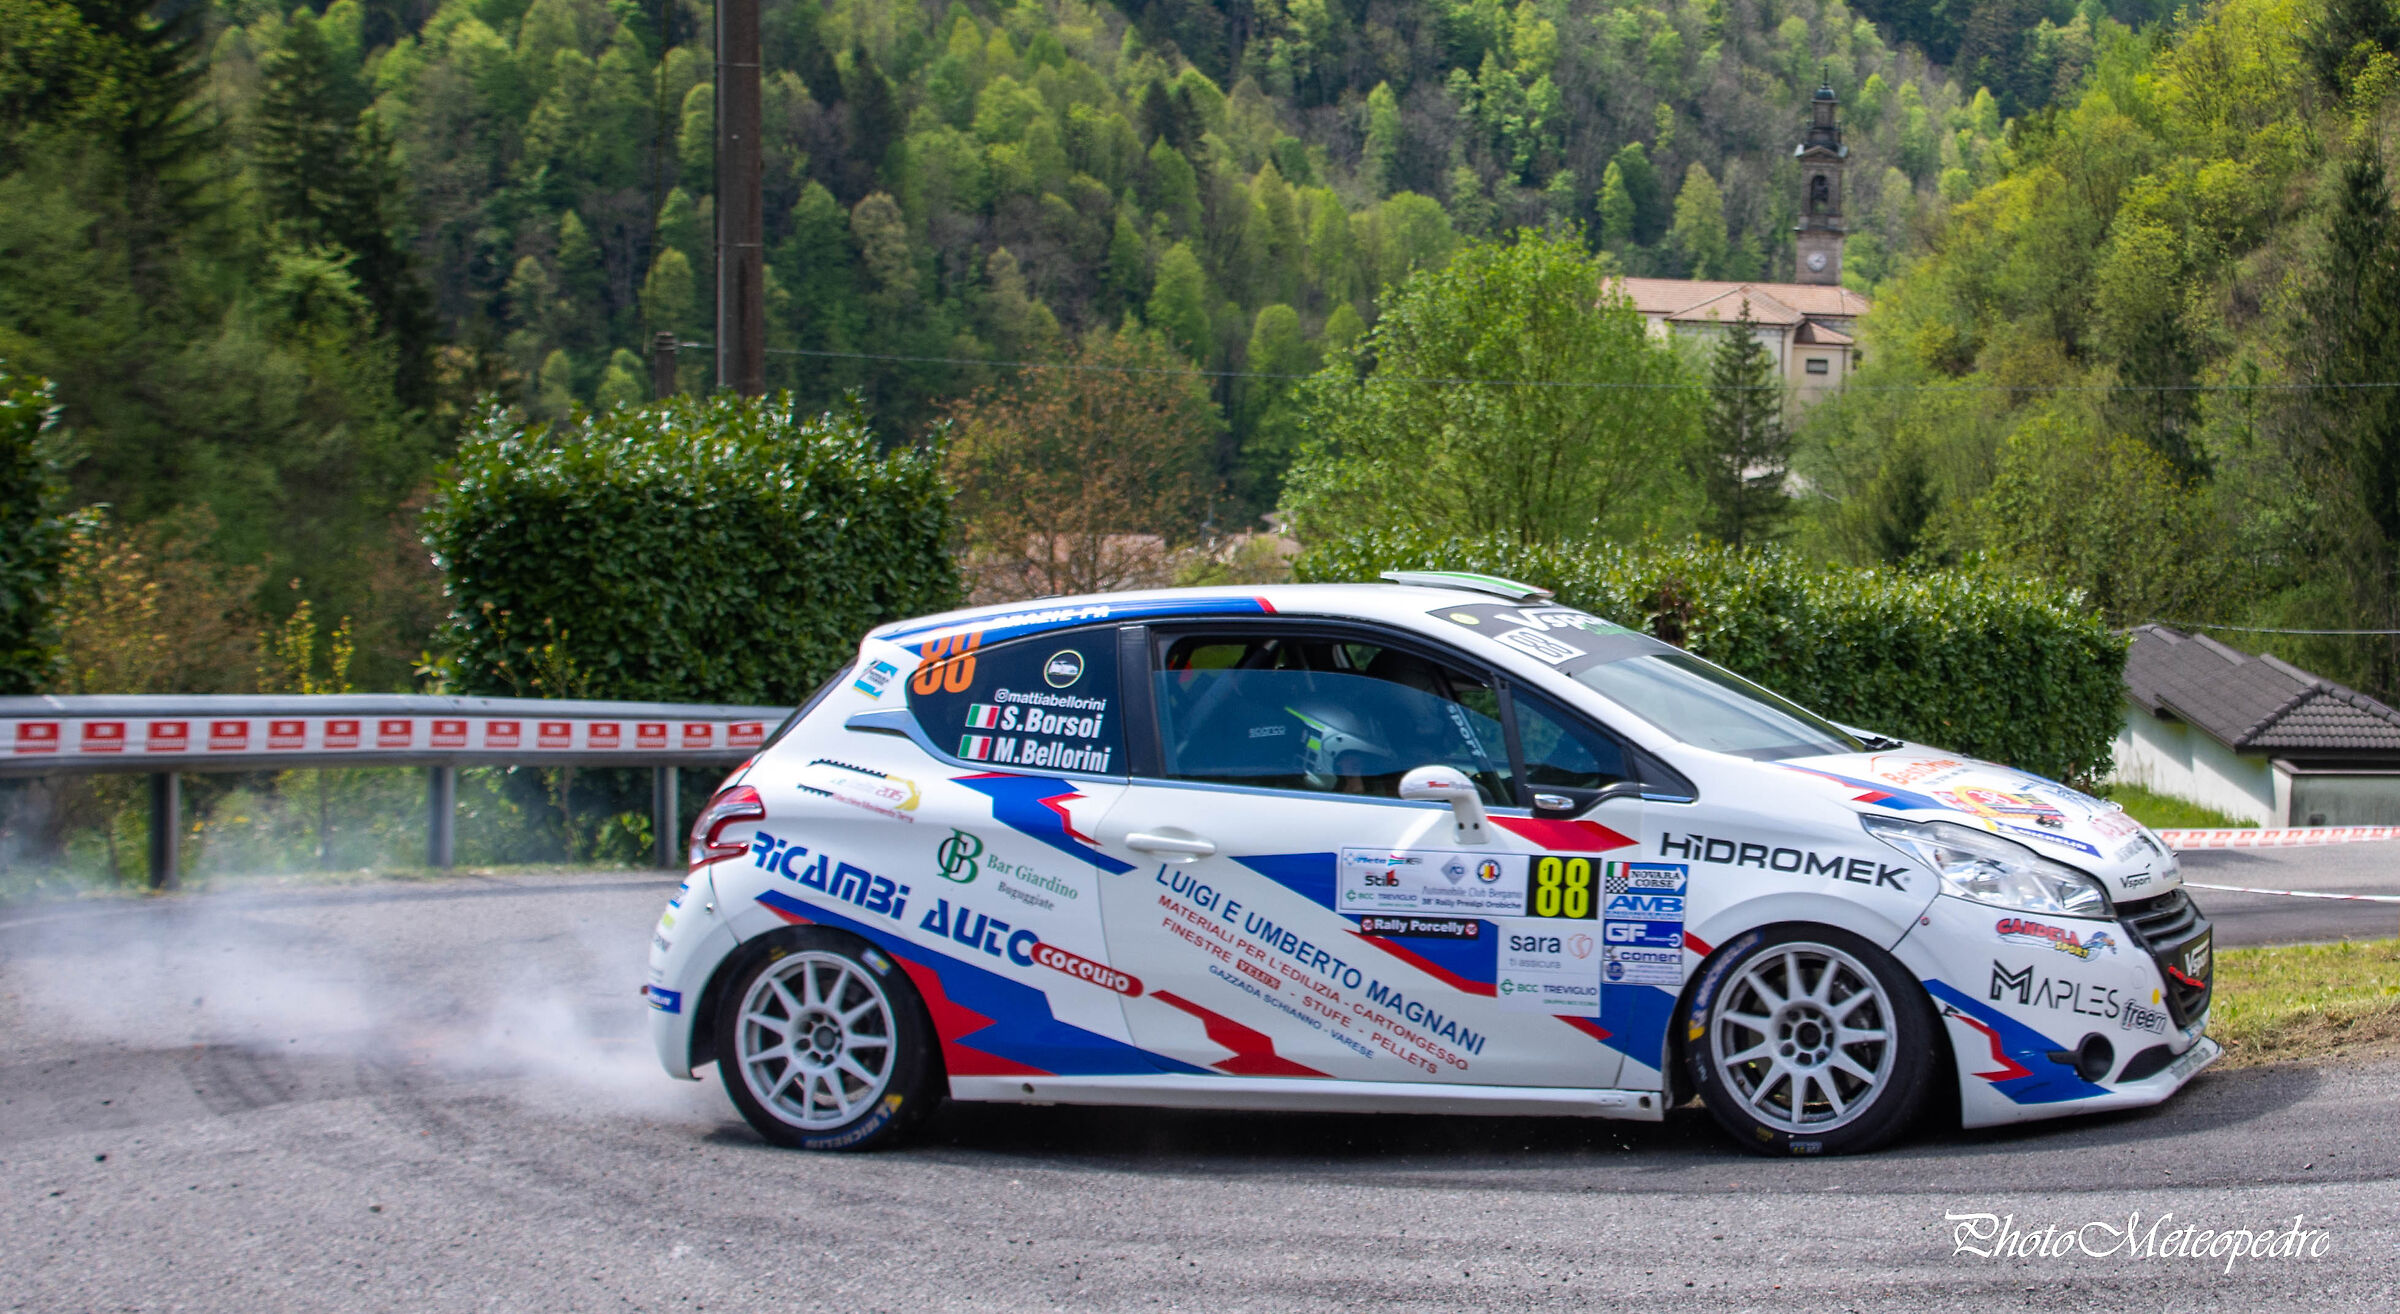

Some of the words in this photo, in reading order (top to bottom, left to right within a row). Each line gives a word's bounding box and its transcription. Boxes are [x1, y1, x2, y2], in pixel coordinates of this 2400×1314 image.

[1507, 631, 1575, 658] 88
[912, 628, 984, 696] 88
[994, 688, 1107, 711] @mattiabellorini
[1000, 705, 1104, 738] S.Borsoi
[993, 736, 1112, 773] M.Bellorini
[986, 854, 1013, 874] Bar
[1015, 865, 1078, 900] Giardino
[1536, 856, 1591, 919] 88
[1631, 870, 1681, 880] NOVARA
[1635, 879, 1675, 887] CORSE
[1607, 895, 1684, 912] AMB
[1373, 919, 1408, 933] Rally
[1410, 919, 1465, 935] Porcelly
[1606, 923, 1647, 942] GF
[1996, 918, 2080, 947] CANDELA
[1156, 863, 1221, 911] LUIGI
[1221, 900, 1243, 923] E
[1244, 912, 1362, 989] UMBERTO
[1366, 980, 1486, 1055] MAGNANI
[1158, 895, 1235, 944] MATERIALI
[1235, 939, 1267, 962] PER
[1268, 957, 1340, 1003] L'EDILIZIA
[1509, 935, 1561, 953] sara
[1161, 917, 1233, 963] FINESTRE
[1302, 995, 1352, 1028] STUFE
[1370, 1032, 1438, 1074] PELLETS
[1517, 983, 1538, 992] BCC
[1543, 984, 1597, 996] TREVIGLIO
[1989, 959, 2120, 1019] MAPLES
[1208, 965, 1261, 997] GAZZADA
[1263, 994, 1322, 1030] SCHIANNO
[1331, 1029, 1375, 1059] VARESE
